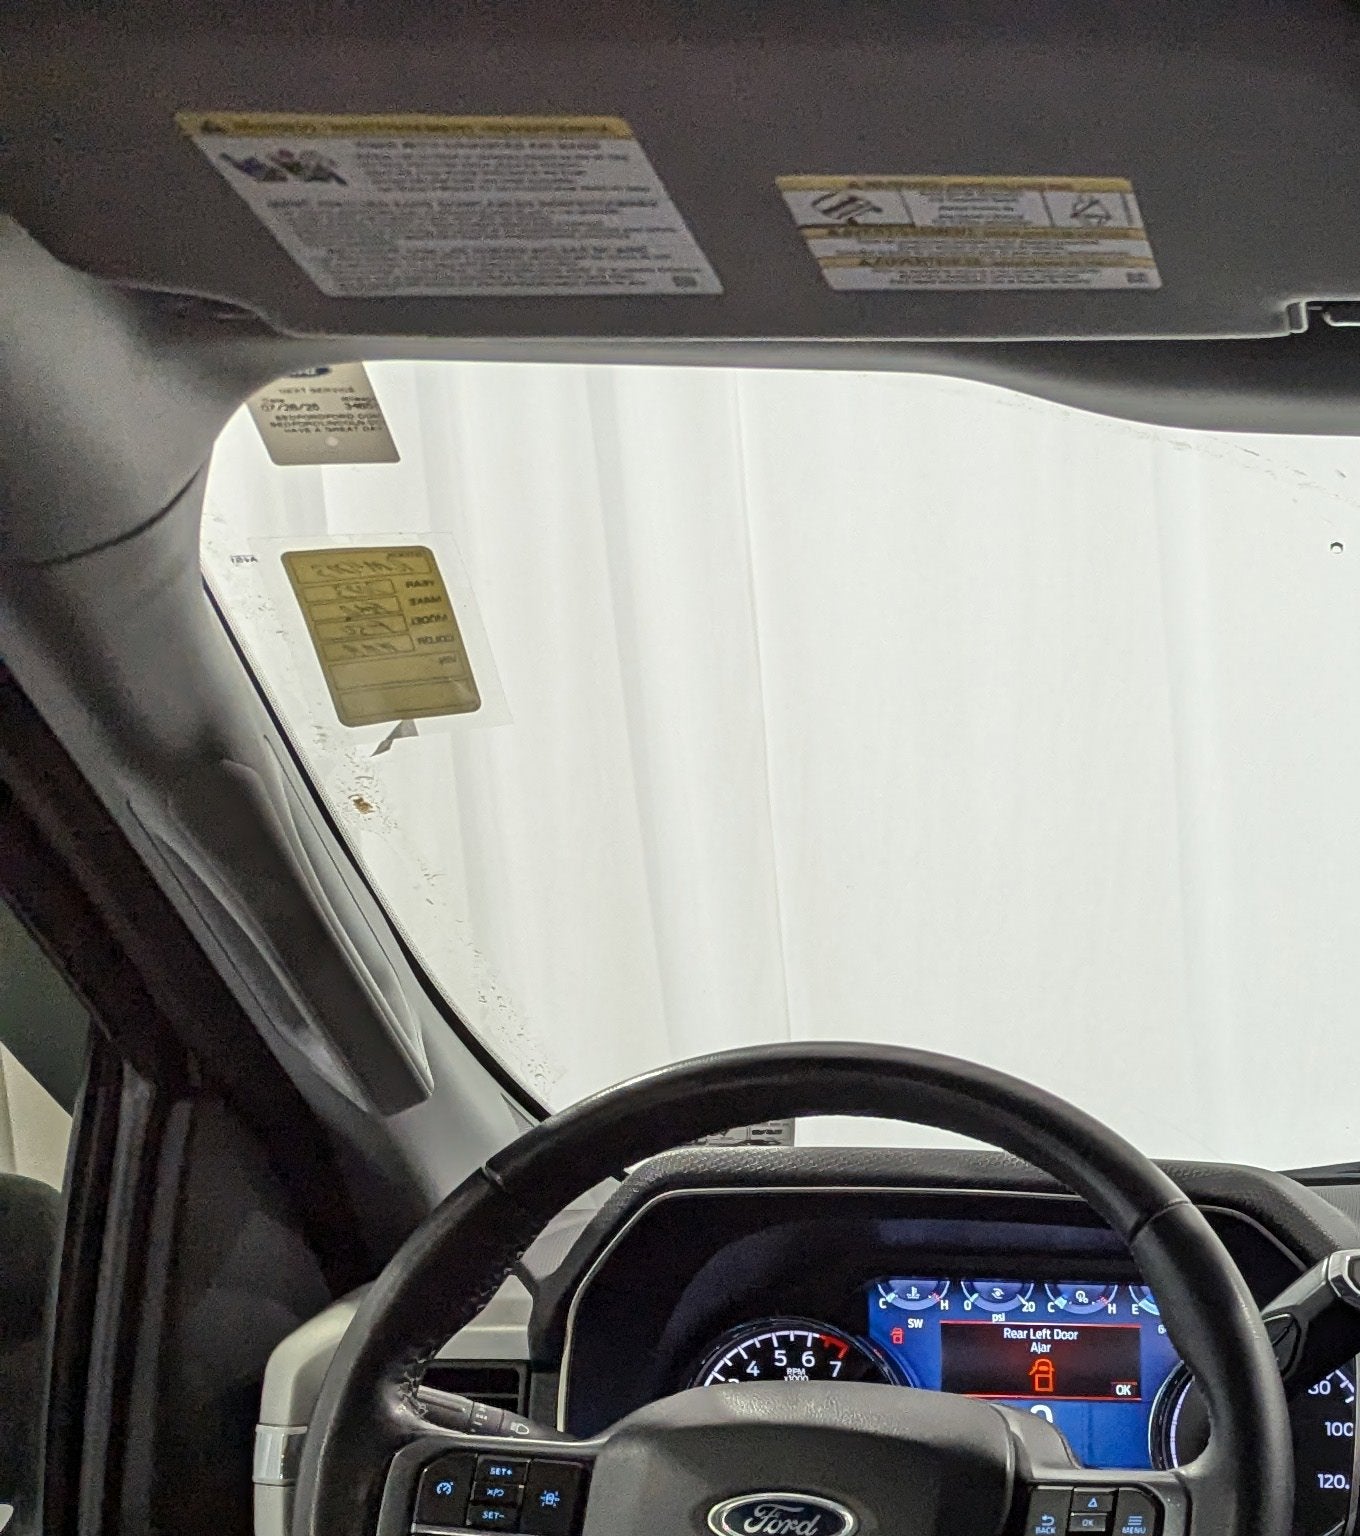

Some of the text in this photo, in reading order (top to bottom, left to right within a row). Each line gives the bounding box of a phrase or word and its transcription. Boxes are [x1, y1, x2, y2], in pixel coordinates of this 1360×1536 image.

[879, 1298, 887, 1309] C
[940, 1300, 949, 1310] H
[1022, 1302, 1035, 1312] 20
[1047, 1303, 1055, 1313] C
[1107, 1304, 1117, 1315] H
[1132, 1305, 1139, 1315] E
[907, 1318, 923, 1329] SW
[992, 1313, 1005, 1323] psi
[1004, 1328, 1078, 1340] Rear Left Door
[1030, 1342, 1051, 1353] Ajar
[774, 1351, 787, 1367] 5
[802, 1351, 815, 1367] 6
[746, 1360, 760, 1377] 4
[829, 1361, 842, 1377] 7
[1116, 1385, 1131, 1395] OK
[743, 1503, 821, 1536] Ford
[1082, 1519, 1094, 1527] OK
[1035, 1527, 1056, 1535] BACK
